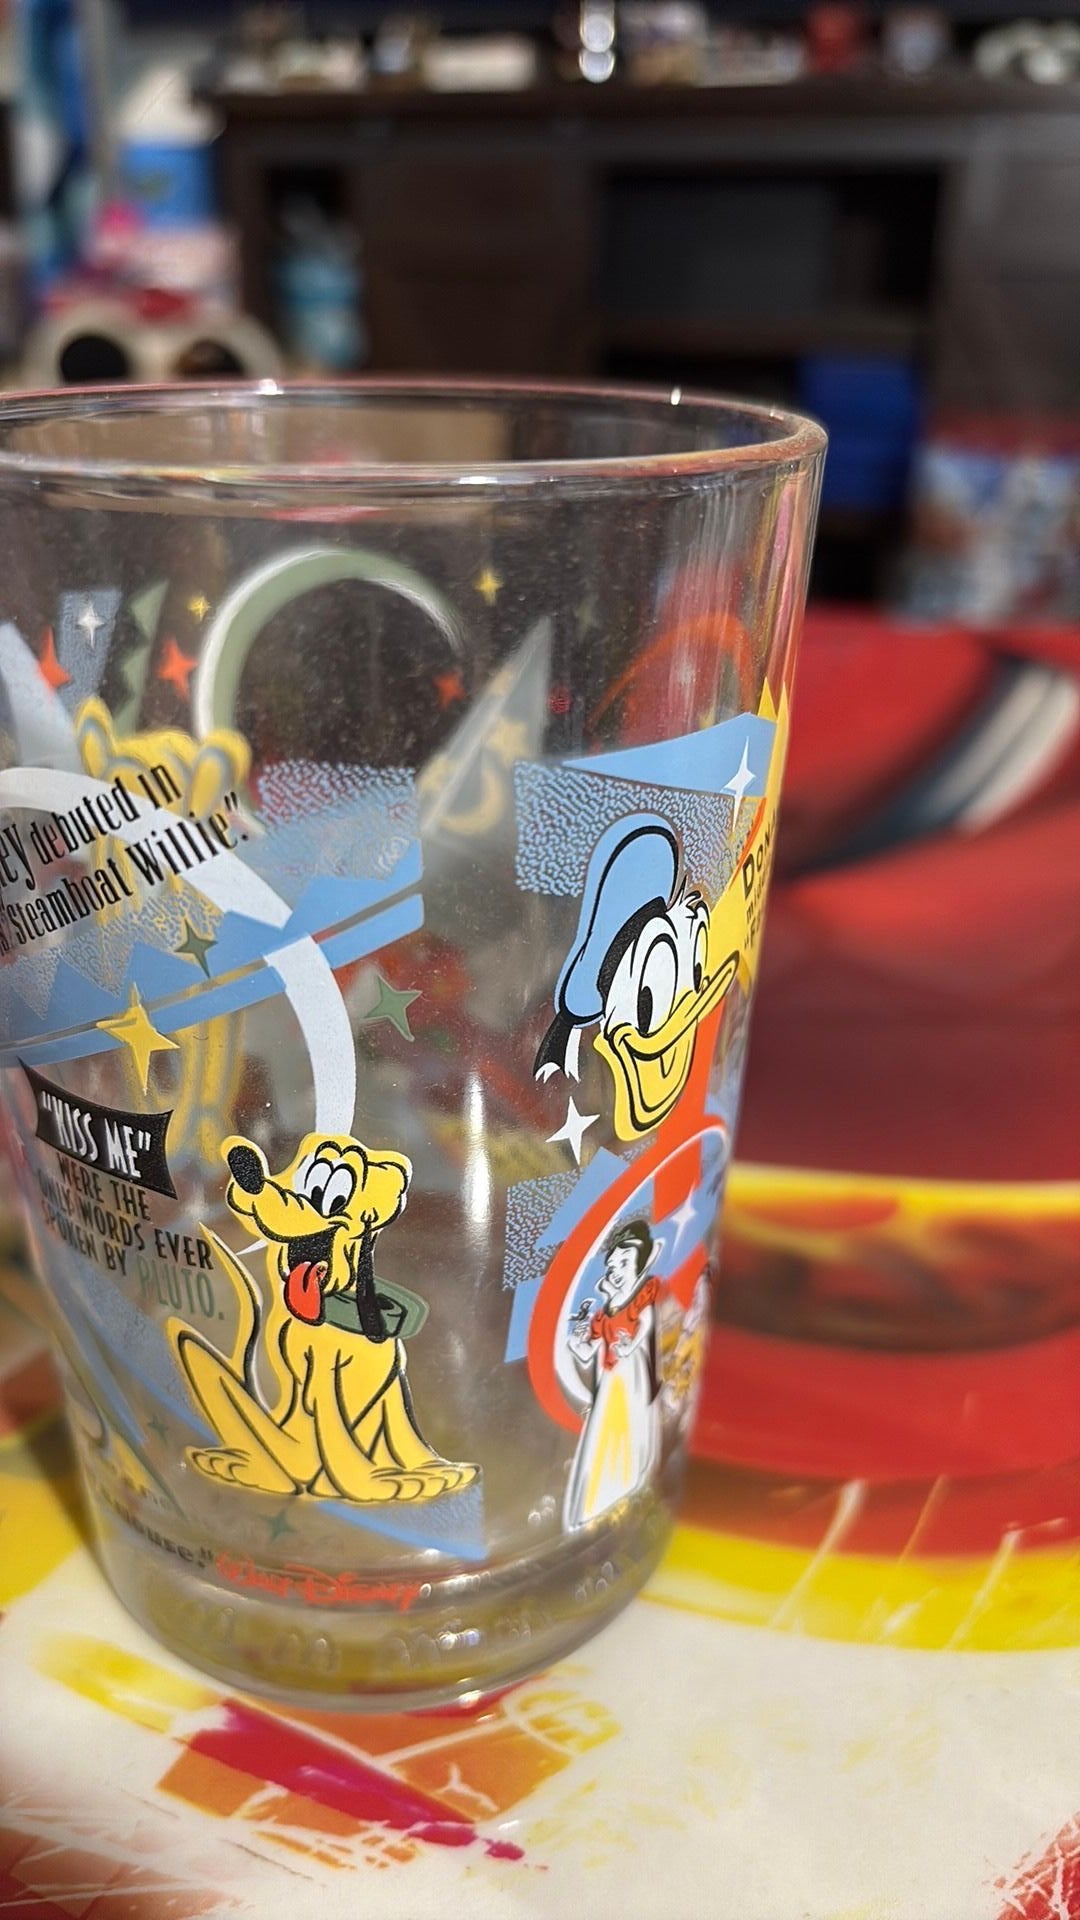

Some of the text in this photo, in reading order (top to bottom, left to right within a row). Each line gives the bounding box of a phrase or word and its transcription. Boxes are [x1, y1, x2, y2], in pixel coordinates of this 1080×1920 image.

[0, 764, 182, 890] ey debuted in
[41, 1090, 151, 1178] "KISS ME"
[56, 1152, 151, 1221] WERE THE
[79, 1196, 145, 1251] WORDS
[154, 1227, 214, 1271] EVER
[103, 1240, 127, 1277] BY
[136, 1253, 225, 1321] PLUTO.
